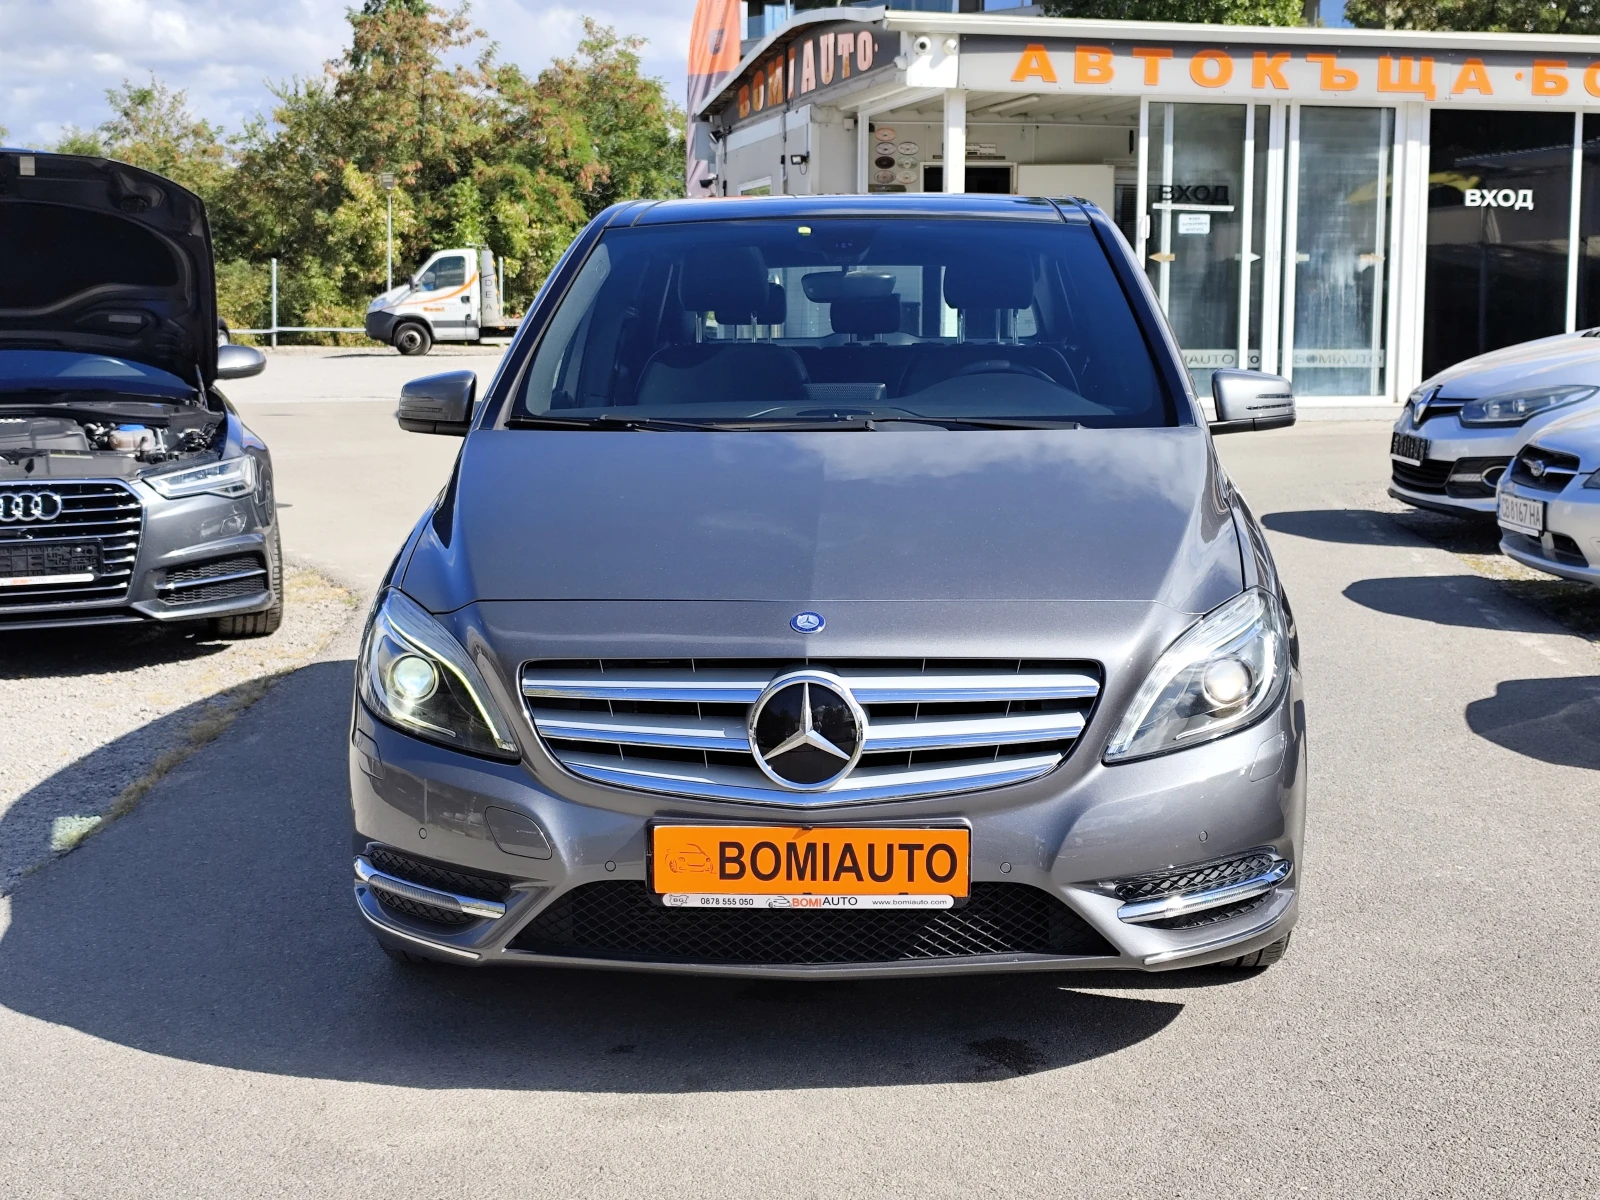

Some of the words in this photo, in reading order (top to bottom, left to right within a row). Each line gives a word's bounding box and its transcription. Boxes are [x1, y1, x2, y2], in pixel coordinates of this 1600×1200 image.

[1160, 185, 1229, 205] ВХОД
[1465, 188, 1534, 210] ВХОД
[718, 841, 958, 883] BOMIAUTO
[700, 897, 720, 905] 0878
[738, 898, 754, 906] 050
